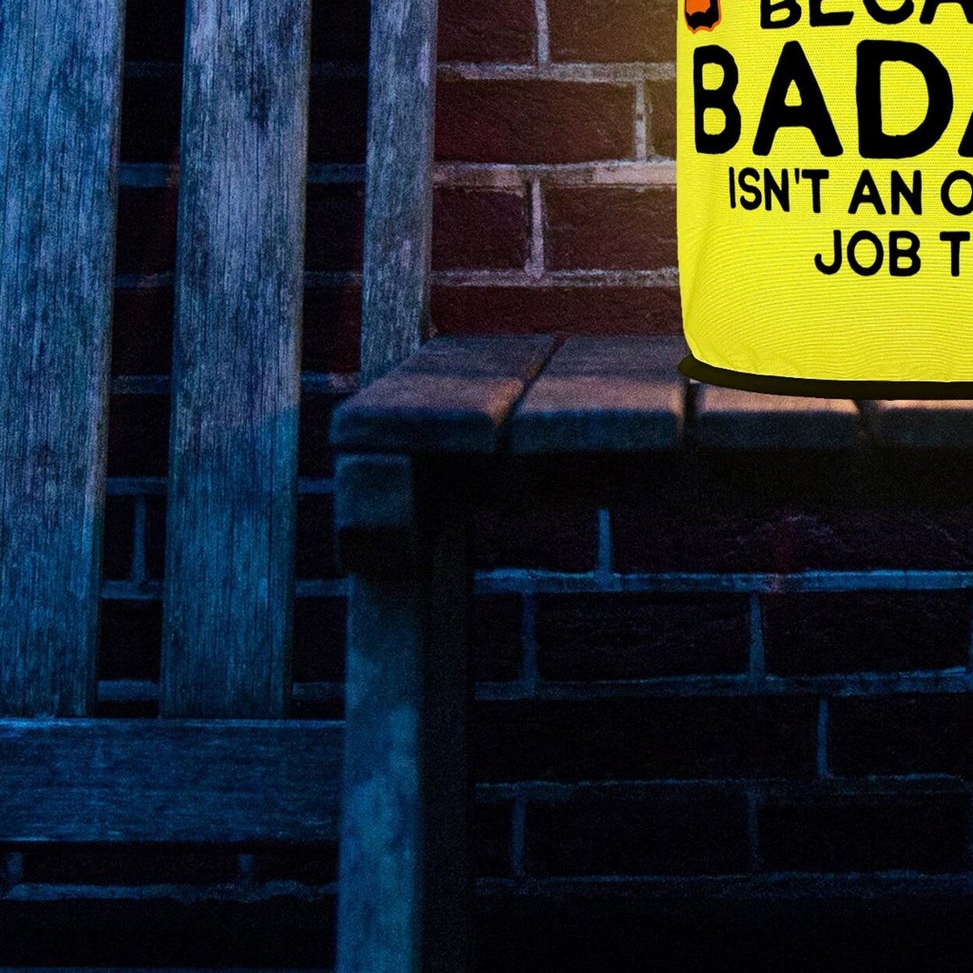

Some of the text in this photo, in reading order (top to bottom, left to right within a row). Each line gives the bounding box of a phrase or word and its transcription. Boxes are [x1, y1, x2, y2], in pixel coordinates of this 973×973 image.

[728, 166, 830, 214] ISN'T
[847, 168, 923, 215] AN
[813, 229, 922, 277] JOB
